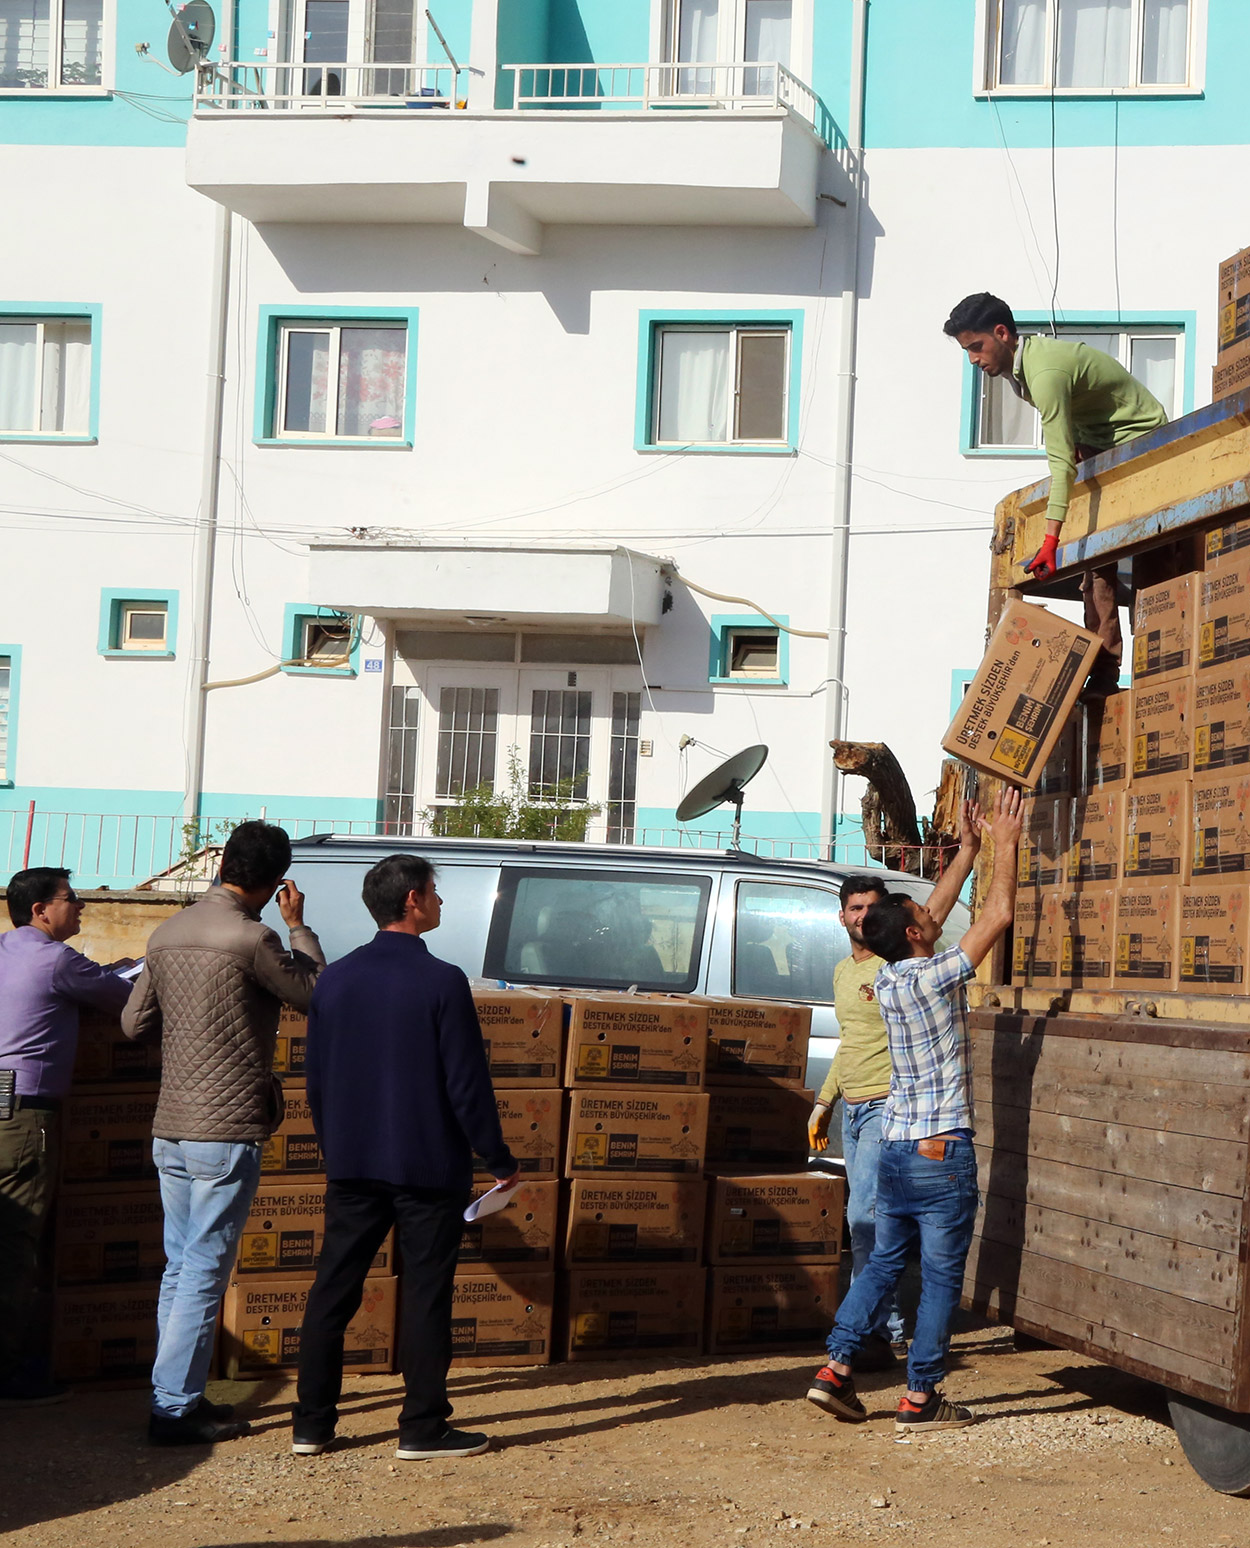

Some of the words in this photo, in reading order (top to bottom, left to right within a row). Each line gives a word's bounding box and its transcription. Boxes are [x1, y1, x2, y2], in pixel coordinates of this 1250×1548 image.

[367, 661, 379, 669] 48
[957, 693, 984, 745] ÜRETMEK
[981, 659, 1005, 696] SİZDEN
[968, 718, 989, 750] DESTEK
[584, 1009, 626, 1022] ÜRETMEK
[629, 1011, 660, 1023] SİZDEN
[583, 1021, 612, 1030] DESTEK
[581, 1098, 623, 1110] ÜRETMEK
[626, 1099, 658, 1110] SİZDEN
[580, 1110, 608, 1119] DESTEK
[581, 1190, 623, 1201] ÜRETMEK
[626, 1190, 657, 1200] SİZDEN
[463, 1282, 498, 1293] SİZDEN
